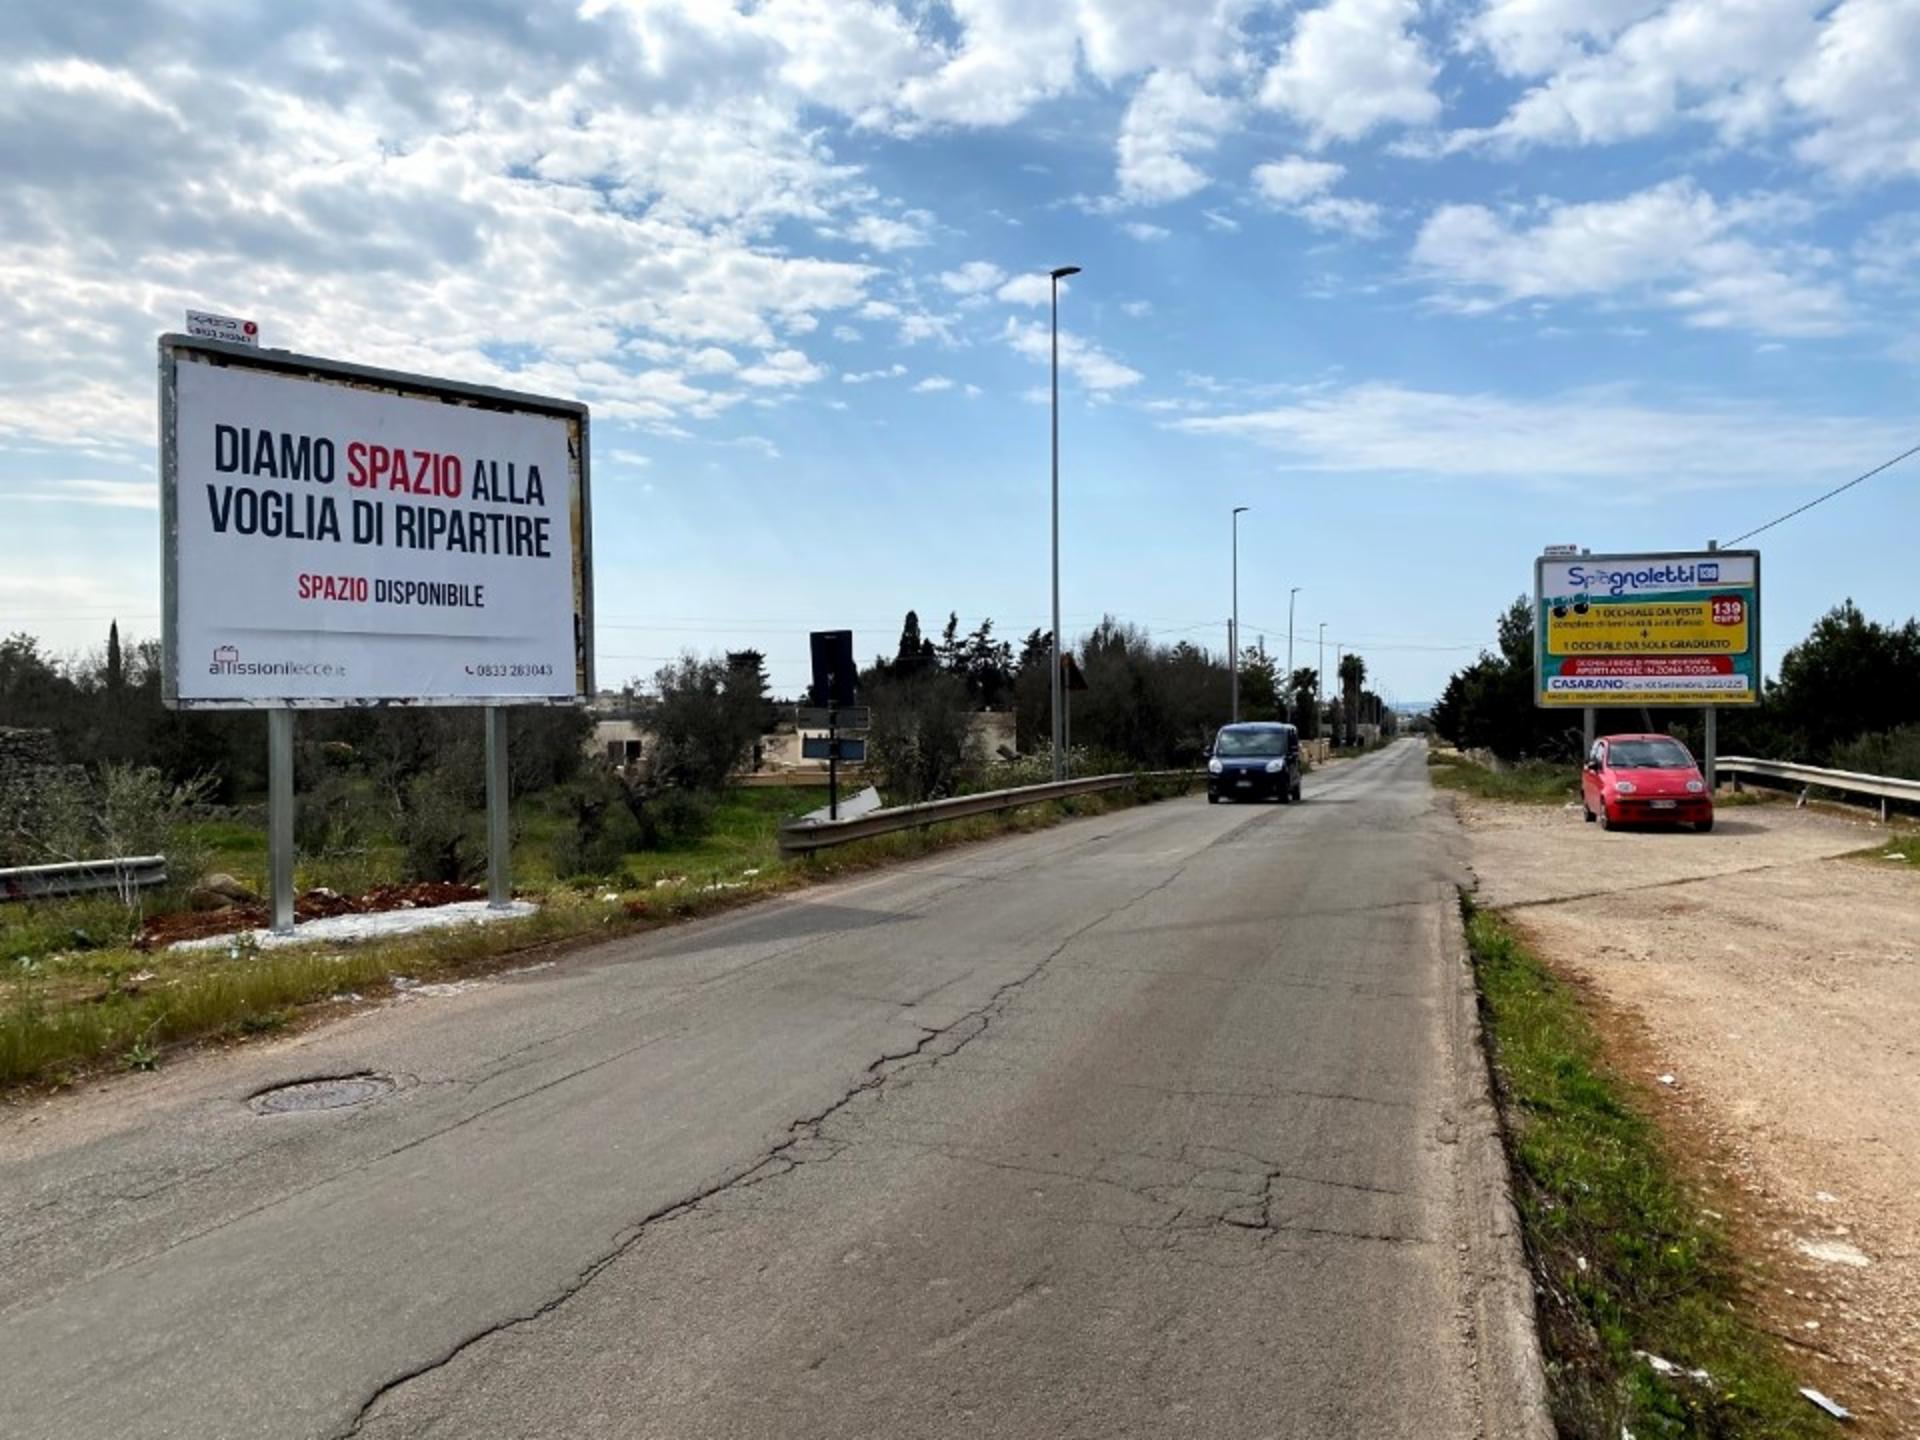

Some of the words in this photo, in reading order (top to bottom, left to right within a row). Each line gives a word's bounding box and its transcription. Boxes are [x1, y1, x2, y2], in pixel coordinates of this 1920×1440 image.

[215, 423, 335, 485] DIAMO
[346, 441, 463, 498] SPAZIO
[472, 459, 545, 506] ALLA
[207, 484, 341, 543] VOGLIA
[353, 499, 384, 546] DI
[395, 504, 551, 558] RIPARTIRE
[1568, 564, 1695, 596] Spagnoletti
[298, 574, 369, 603] SPAZIO
[375, 579, 485, 609] DISPONIBILE
[1603, 607, 1654, 618] OCCHIALE
[1656, 607, 1672, 617] DA
[1674, 606, 1704, 616] VISTA
[1712, 602, 1742, 615] 139
[1713, 614, 1742, 624] euro
[1571, 641, 1622, 651] OCCHIALE
[1624, 641, 1639, 650] DA
[1640, 640, 1668, 649] SOLE
[1670, 639, 1732, 649] GRADUATO
[1576, 666, 1609, 675] APERTI
[1610, 666, 1643, 675] ANCHE
[1656, 666, 1683, 674] ZONA
[1552, 679, 1624, 689] CASARANO
